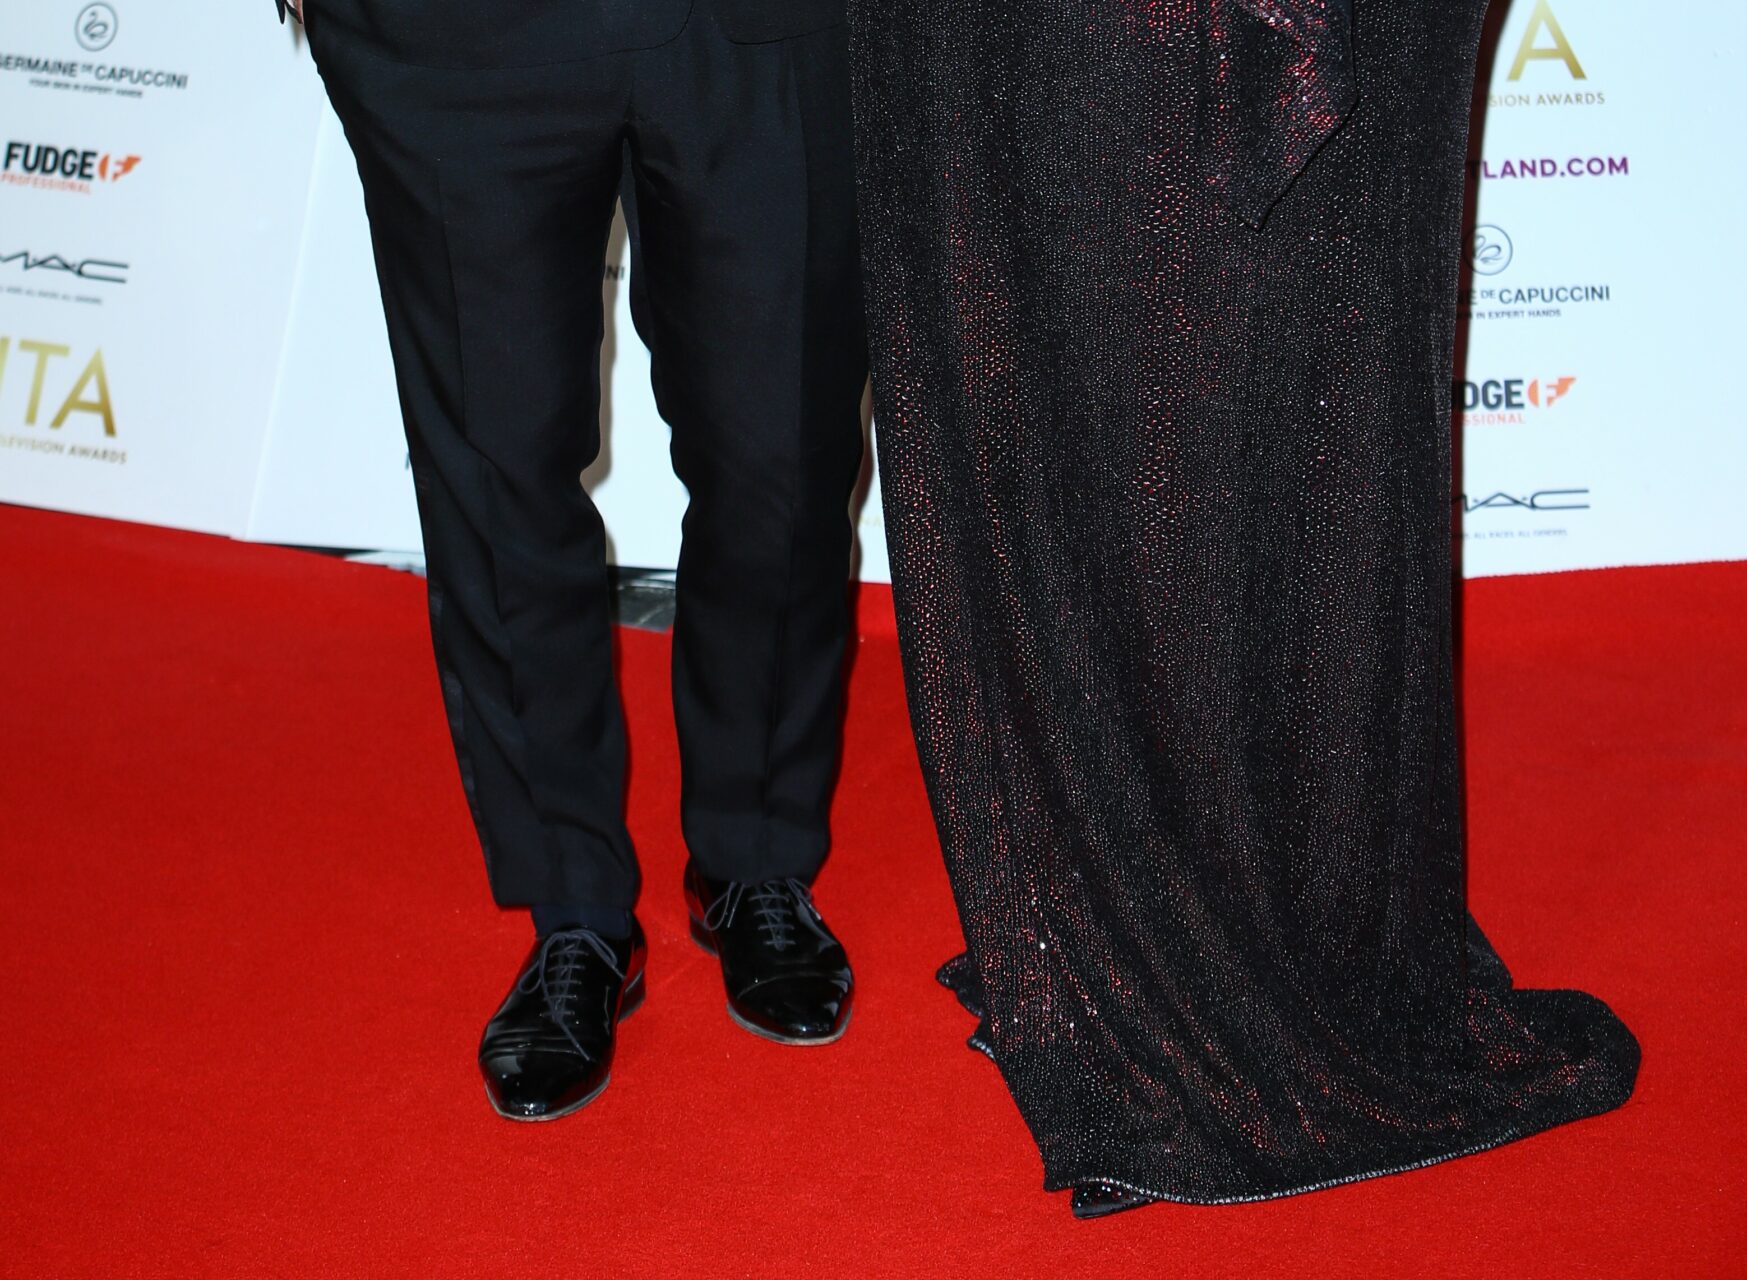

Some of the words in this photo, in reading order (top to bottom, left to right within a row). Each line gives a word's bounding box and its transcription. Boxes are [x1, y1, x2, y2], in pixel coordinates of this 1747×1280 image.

[95, 65, 190, 90] CAPUCCINI
[1537, 92, 1606, 107] AWARDS
[4, 141, 98, 181] FUDGE
[1499, 286, 1611, 305] CAPUCCINI
[0, 336, 117, 439] TA
[68, 443, 128, 465] AWARDS
